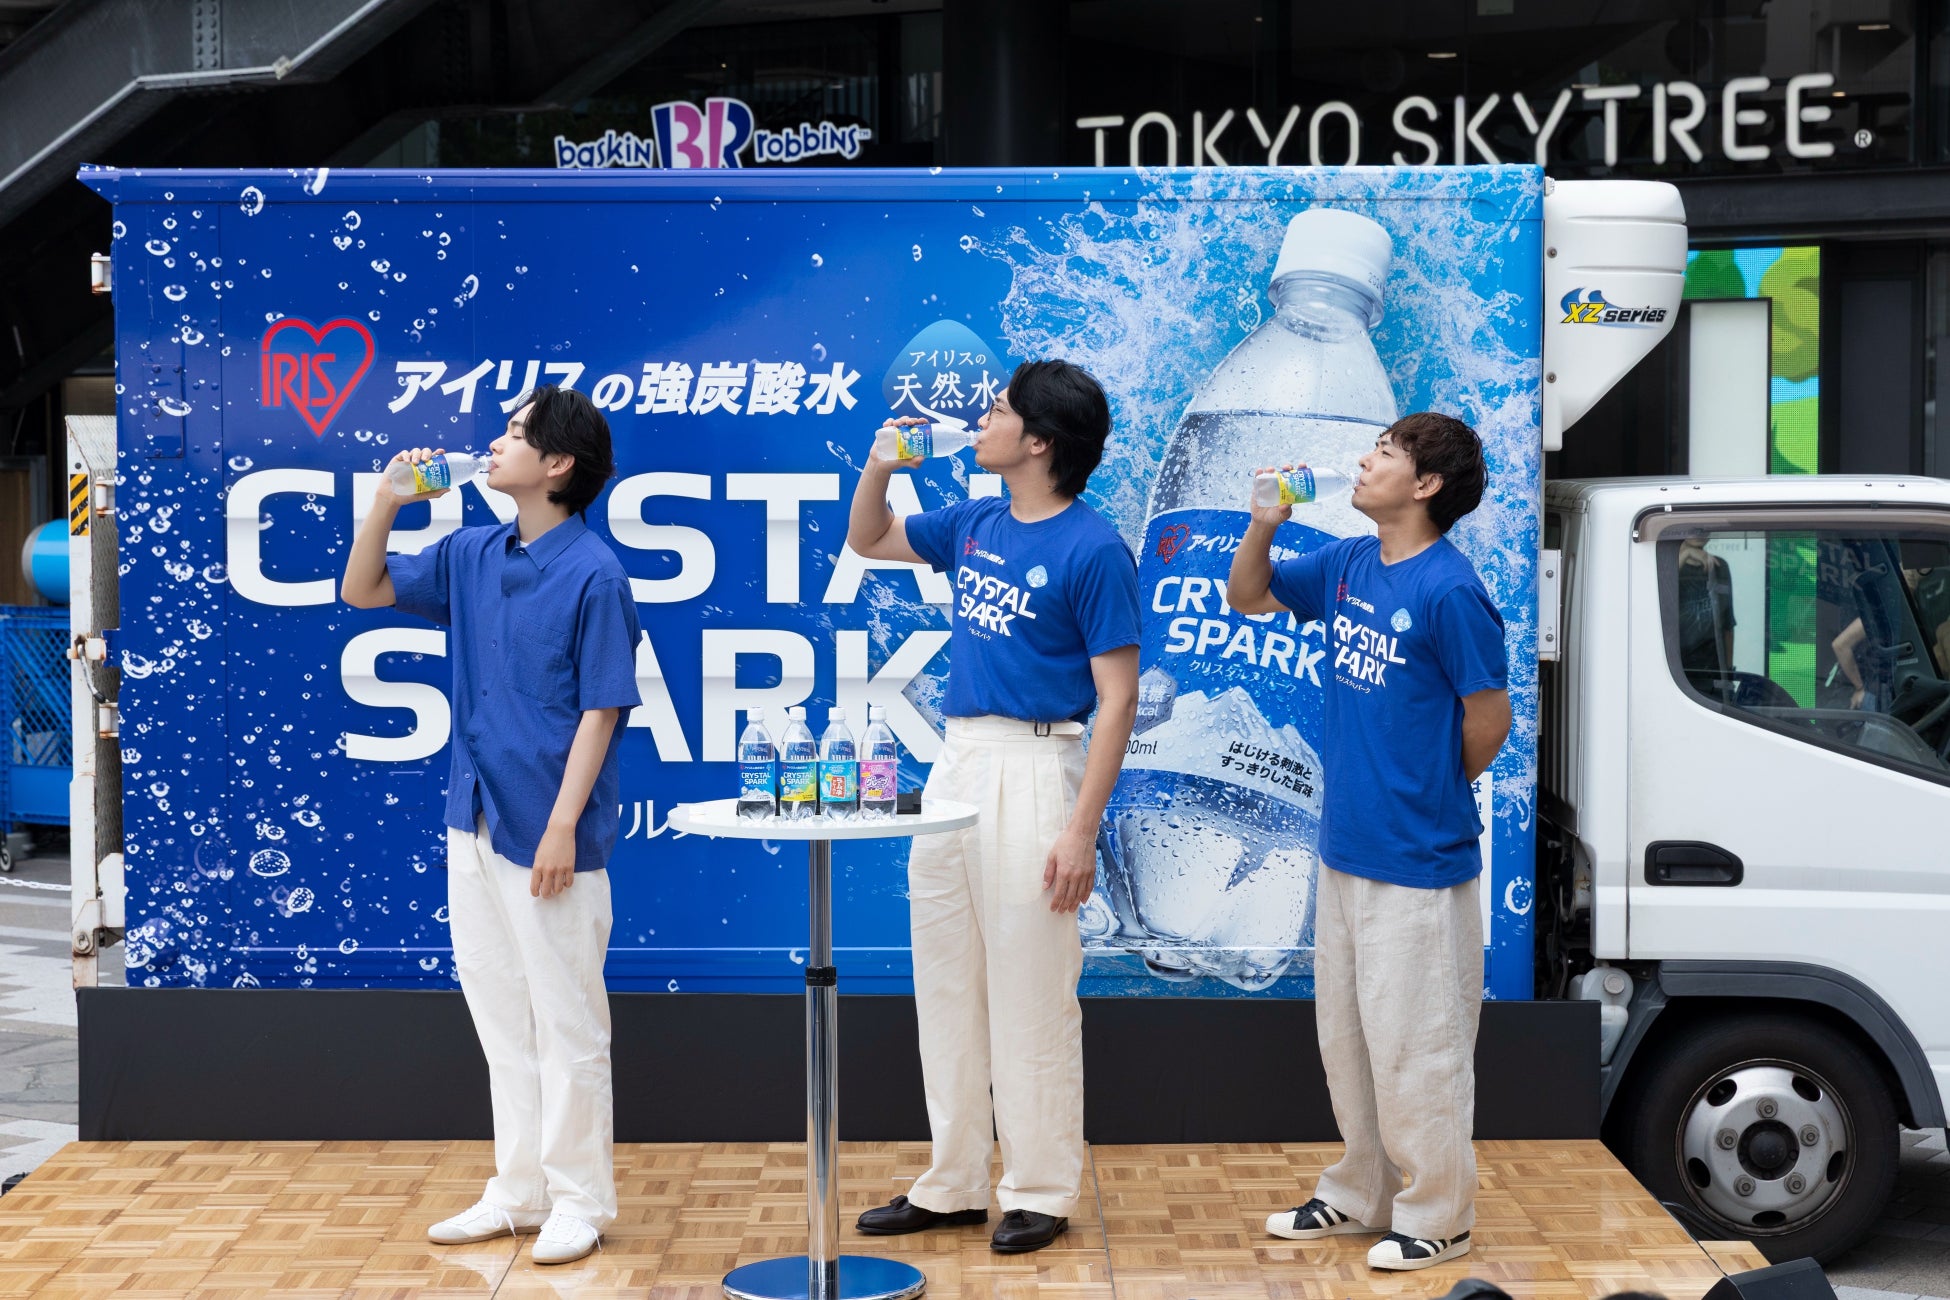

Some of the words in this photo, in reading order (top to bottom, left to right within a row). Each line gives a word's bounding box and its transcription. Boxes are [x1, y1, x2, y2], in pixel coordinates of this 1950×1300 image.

[555, 132, 654, 168] baskin
[651, 98, 755, 168] BR
[755, 123, 860, 163] robbins
[1076, 101, 1360, 167] TOKYO
[1392, 72, 1834, 167] SKYTREE
[1561, 303, 1606, 324] XZ
[1603, 306, 1667, 323] series
[262, 353, 337, 408] IRIS
[910, 349, 987, 368] アイリスの
[889, 369, 1000, 411] 天然水
[226, 468, 1001, 607] CSTA
[1164, 617, 1326, 688] SPARK
[1333, 611, 1407, 665] RYSTAL
[1334, 641, 1387, 688] PARK
[340, 626, 952, 763] SRK
[1221, 755, 1314, 798] すっきりした旨味
[1228, 740, 1313, 781] はじける刺激と
